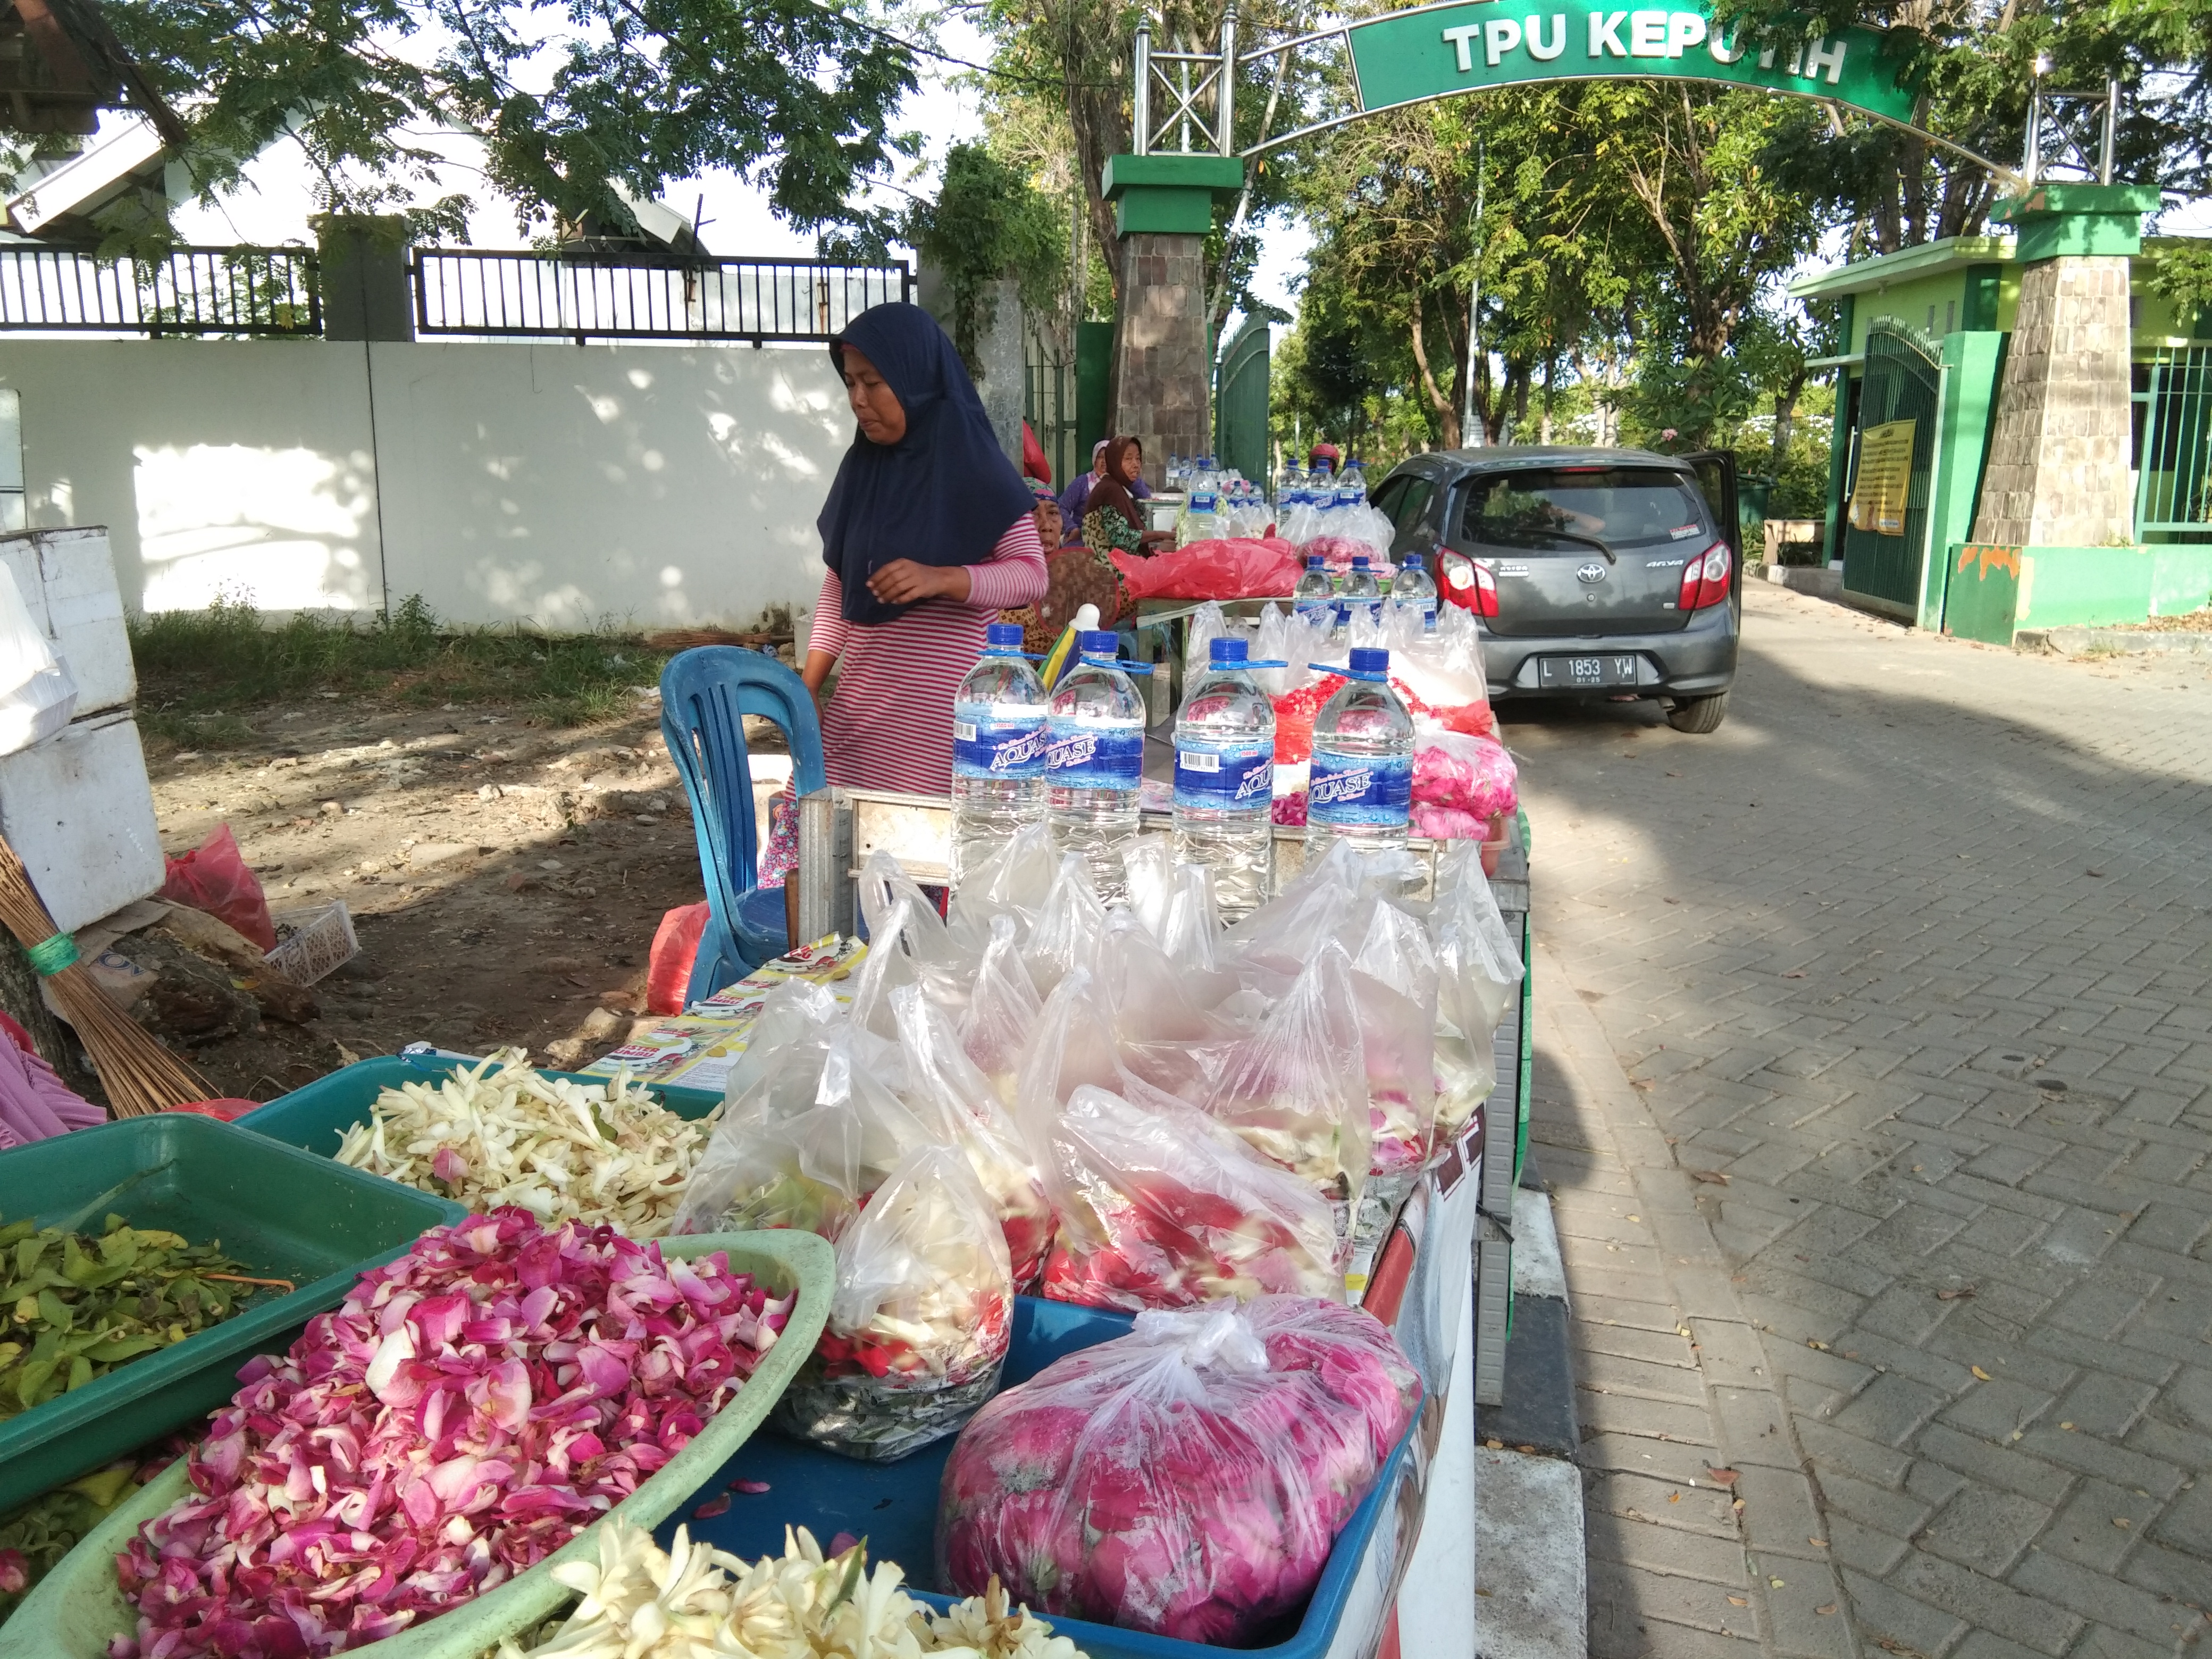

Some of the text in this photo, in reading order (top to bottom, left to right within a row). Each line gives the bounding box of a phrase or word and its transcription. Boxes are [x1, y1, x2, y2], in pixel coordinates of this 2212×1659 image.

[1443, 14, 1566, 72] TPU
[1543, 658, 1633, 677] L 1853 YW
[990, 732, 1048, 772] AQUAS
[1046, 737, 1096, 769] QUASE
[613, 1049, 656, 1058] UMBU
